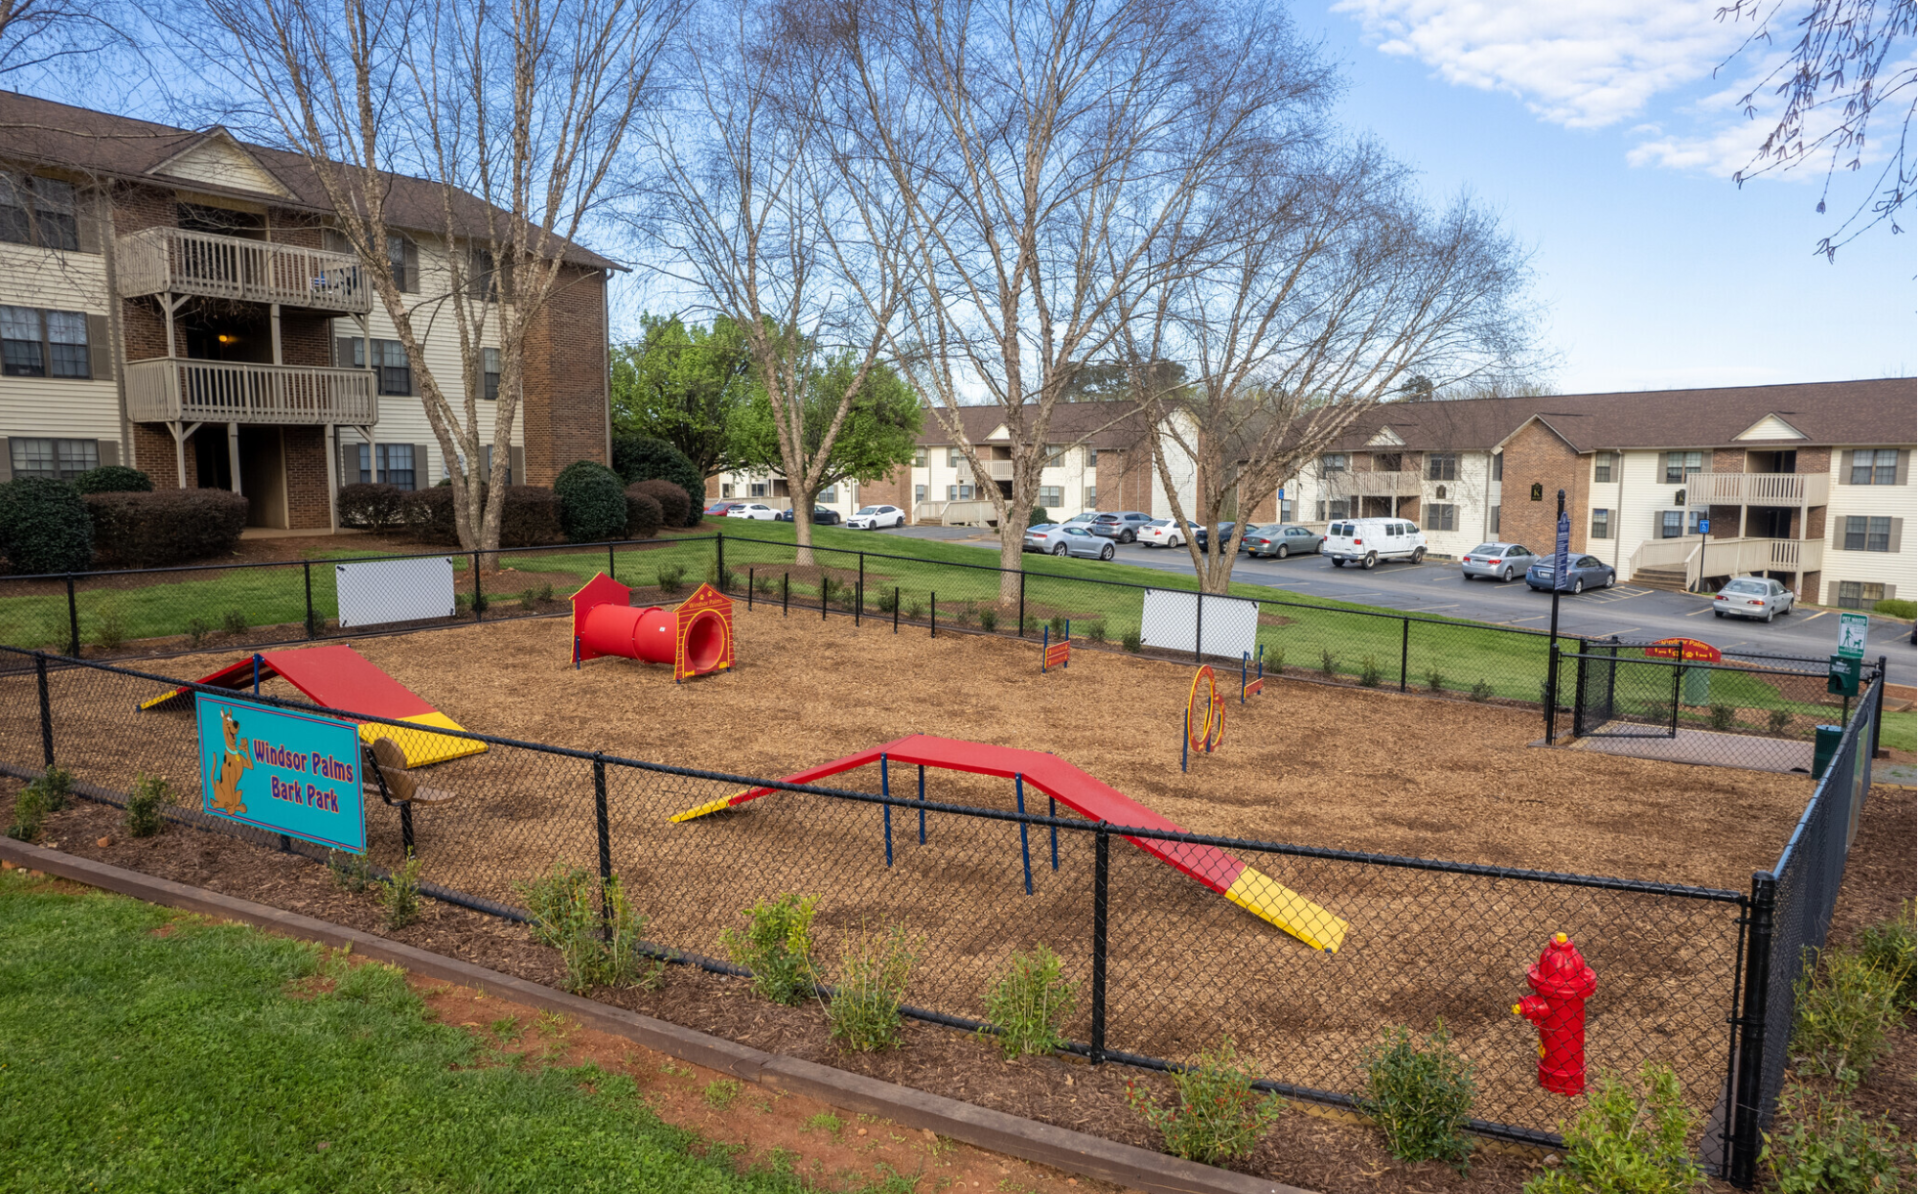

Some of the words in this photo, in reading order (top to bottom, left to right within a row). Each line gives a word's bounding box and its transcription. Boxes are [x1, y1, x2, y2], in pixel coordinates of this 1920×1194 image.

[1689, 640, 1709, 650] Palms
[253, 739, 308, 772] Windsor
[312, 751, 354, 783] Palms
[271, 775, 303, 805] Bark
[306, 784, 339, 813] Park
